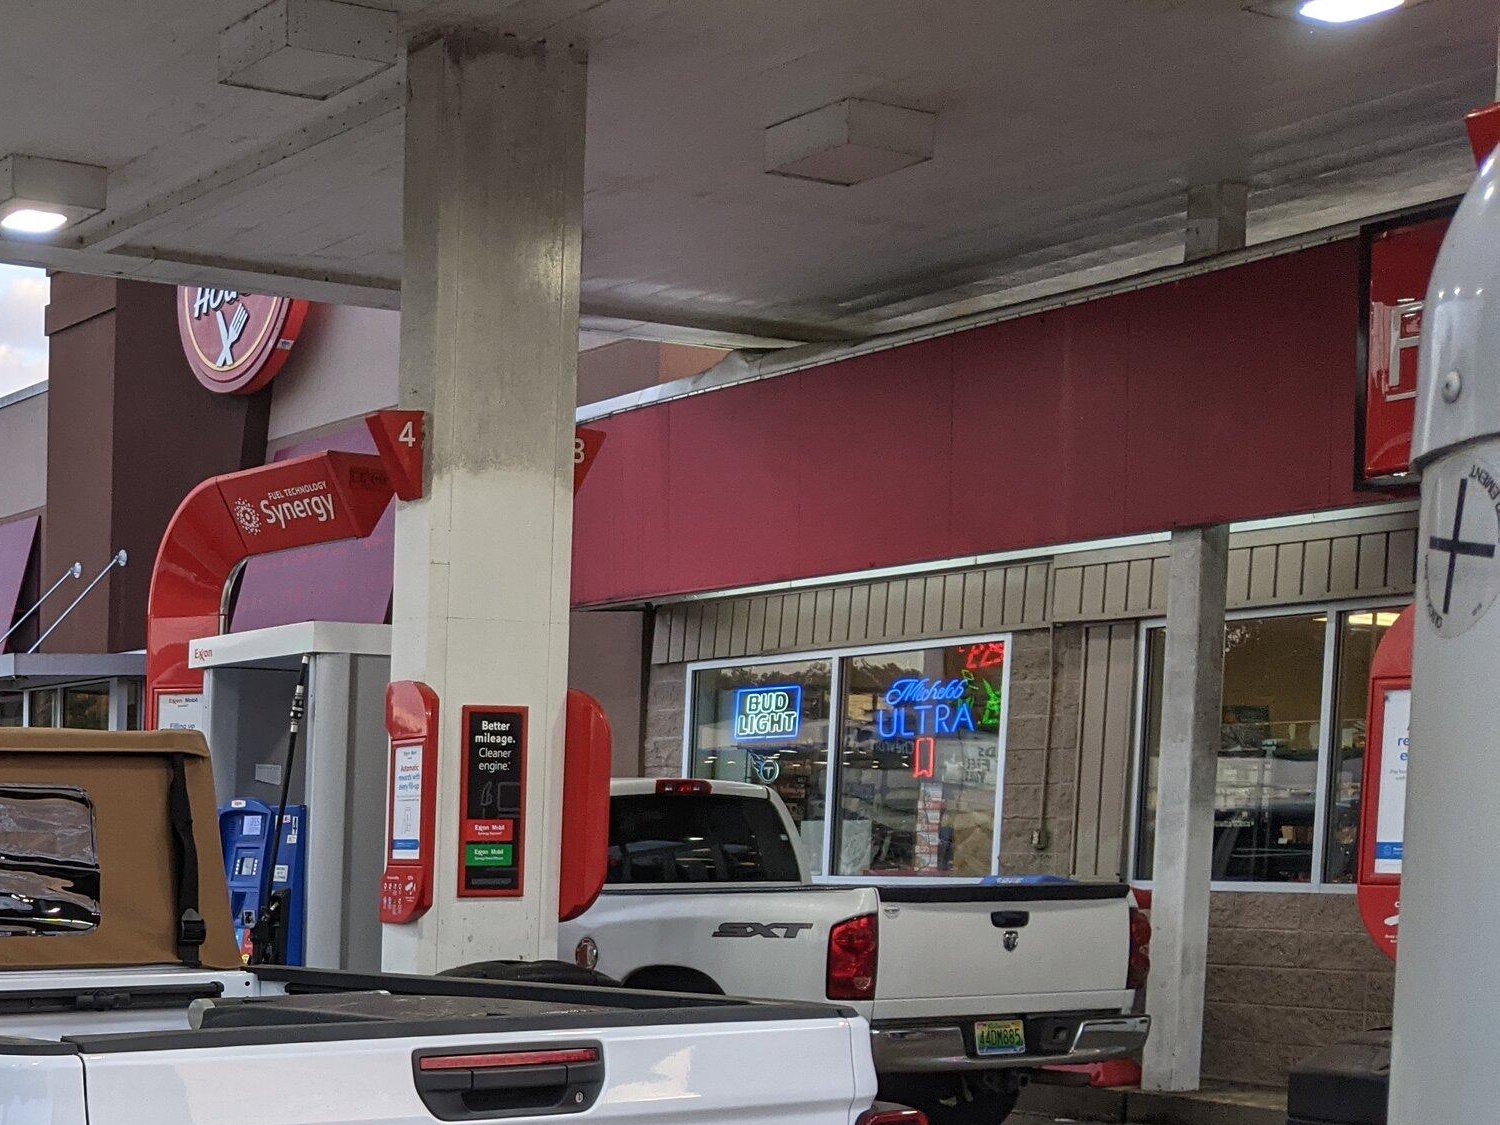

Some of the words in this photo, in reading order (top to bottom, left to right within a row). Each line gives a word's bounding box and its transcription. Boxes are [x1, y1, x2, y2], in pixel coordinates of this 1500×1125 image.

[399, 421, 416, 448] 4
[267, 491, 285, 501] FUEL
[283, 481, 327, 497] TECHNOLOGY
[260, 493, 335, 529] Synergy
[194, 648, 213, 661] Exxon
[885, 678, 970, 705] Michelob
[746, 692, 789, 714] BUD
[481, 720, 511, 731] Better
[737, 711, 797, 735] LIGHT
[878, 703, 975, 738] ULTRA
[475, 732, 516, 745] mileage.
[479, 747, 511, 758] Cleaner
[474, 824, 490, 832] Exxon
[474, 848, 489, 856] Exxon
[711, 922, 814, 939] SXT
